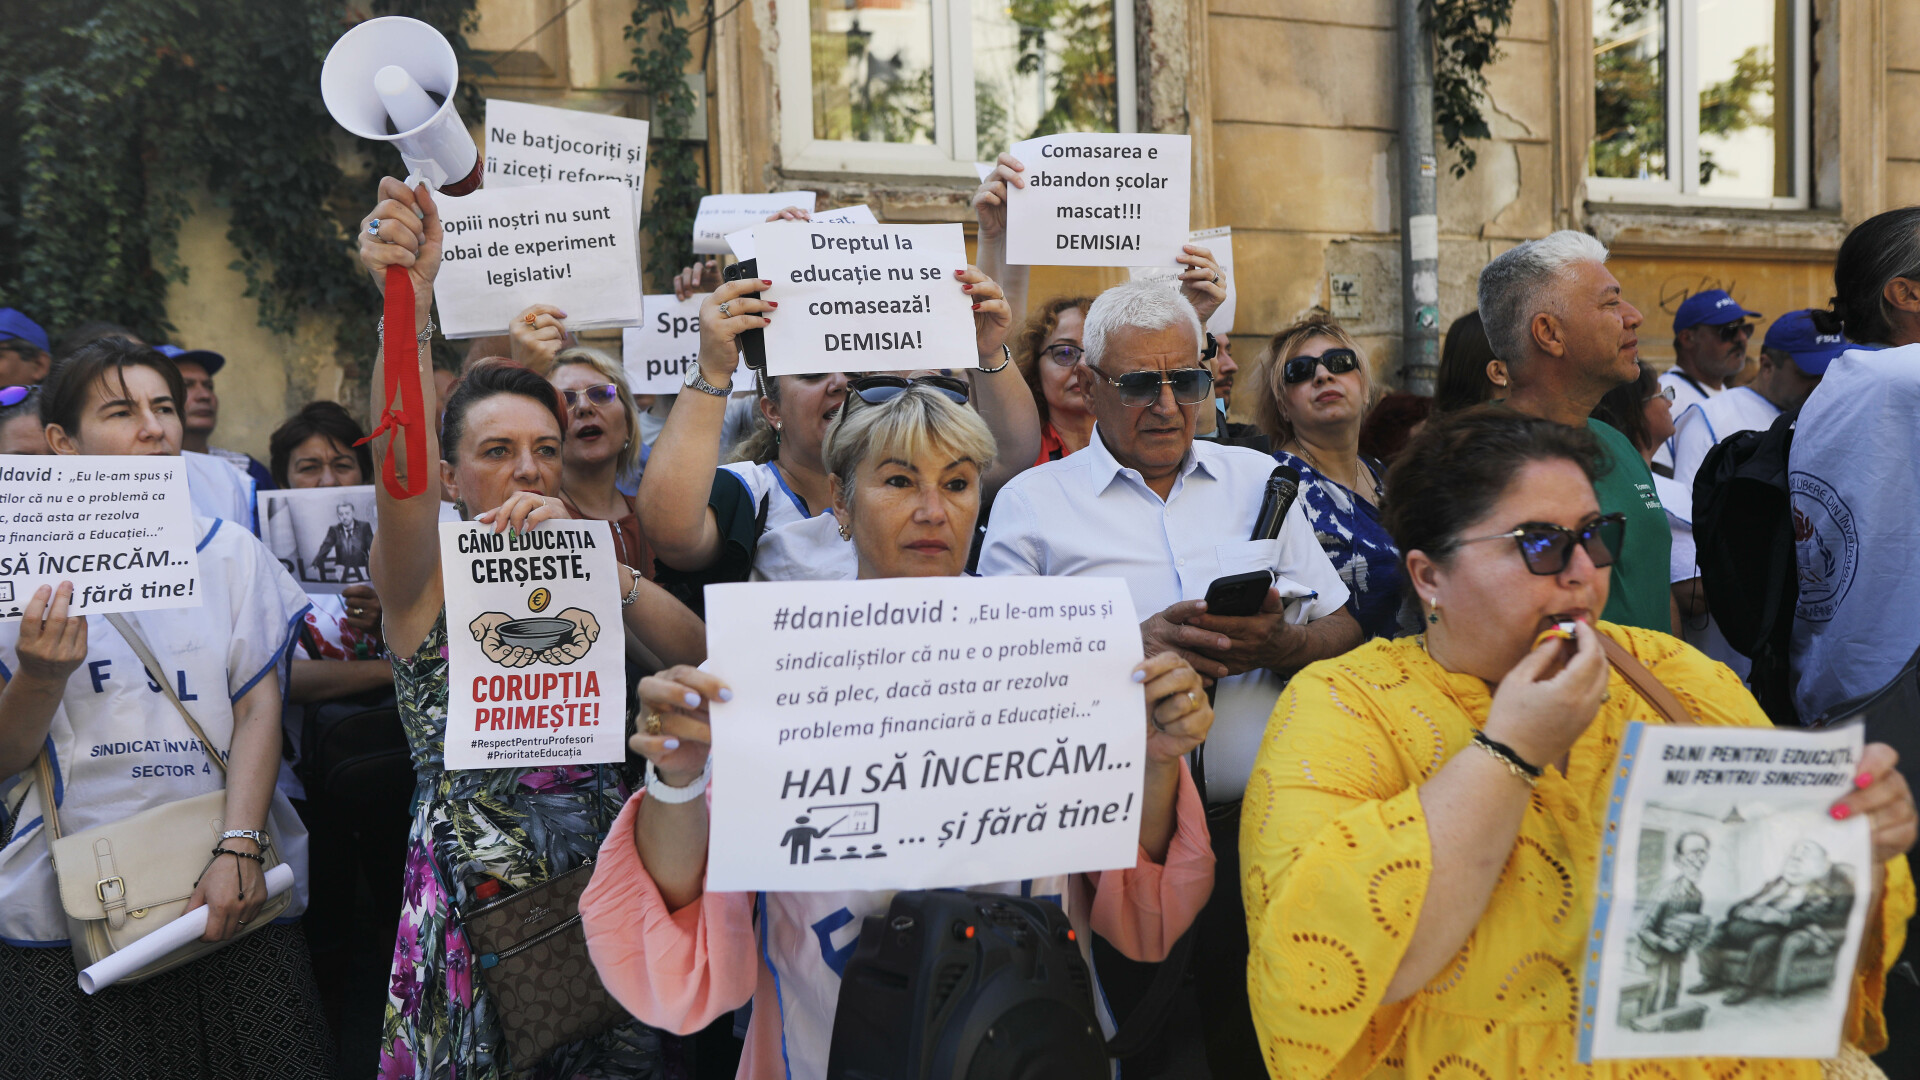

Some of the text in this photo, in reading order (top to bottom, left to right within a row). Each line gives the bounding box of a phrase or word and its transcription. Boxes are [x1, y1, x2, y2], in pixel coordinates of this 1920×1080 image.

[492, 128, 640, 164] Ne batjocoriți și
[1042, 145, 1157, 159] Comasarea e
[488, 157, 496, 173] îi
[503, 160, 551, 182] ziceți
[1030, 171, 1168, 191] abandon școlar
[489, 211, 539, 230] noștri
[545, 212, 566, 224] nu
[573, 207, 610, 221] sunt
[1057, 204, 1140, 219] mascat!!!
[488, 242, 509, 257] de
[515, 234, 616, 256] experiment
[811, 234, 912, 254] Dreptul la
[1057, 235, 1140, 250] DEMISIA!
[487, 263, 571, 287] legislativ!
[791, 265, 941, 285] educație nu se
[809, 295, 930, 315] comasează!
[657, 312, 701, 338] Spa
[825, 331, 922, 351] DEMISIA!
[70, 472, 91, 482] „Eu
[96, 471, 130, 481] le-am
[134, 473, 160, 482] spus
[164, 471, 172, 482] și
[29, 494, 42, 503] că
[89, 492, 148, 504] problemă
[13, 513, 43, 522] dacă
[47, 513, 74, 522] asta
[95, 510, 139, 520] rezolva
[9, 531, 74, 544] financiară
[458, 527, 597, 554] CÂND EDUCAȚIA
[0, 547, 188, 576] SĂ ÎNCERCĂM...
[472, 555, 590, 590] CERȘESTE,
[80, 583, 132, 608] fără
[141, 579, 194, 598] tine!
[774, 600, 943, 630] #danieldavid
[970, 605, 999, 624] „Eu
[1006, 603, 1053, 619] le-am
[1060, 605, 1095, 620] spus
[1101, 600, 1112, 619] și
[776, 637, 1105, 671] sindicaliștilor că nu e o problemă ca
[88, 660, 111, 694] F
[177, 670, 199, 701] L
[473, 671, 600, 706] CORUPȚIA
[777, 672, 1068, 706] eu să plec, dacă asta ar rezolva
[475, 700, 599, 733] PRIMEȘTE!
[779, 721, 873, 745] problema
[880, 711, 975, 738] financiară
[982, 714, 991, 726] a
[91, 741, 160, 757] SINDICAT
[471, 734, 593, 751] #RespectPentruProfesori
[487, 746, 581, 759] #PrioritateEducația
[1662, 744, 1705, 761] BANI
[1709, 746, 1778, 763] PENTRU
[132, 762, 212, 778] SECTOR 4
[781, 737, 1130, 799] HAI SĂ ÎNCERCĂM...
[1665, 769, 1691, 785] NU
[1693, 769, 1761, 786] PENTRU
[938, 812, 968, 848] și
[971, 802, 1048, 845] fără
[1059, 792, 1133, 828] tine!
